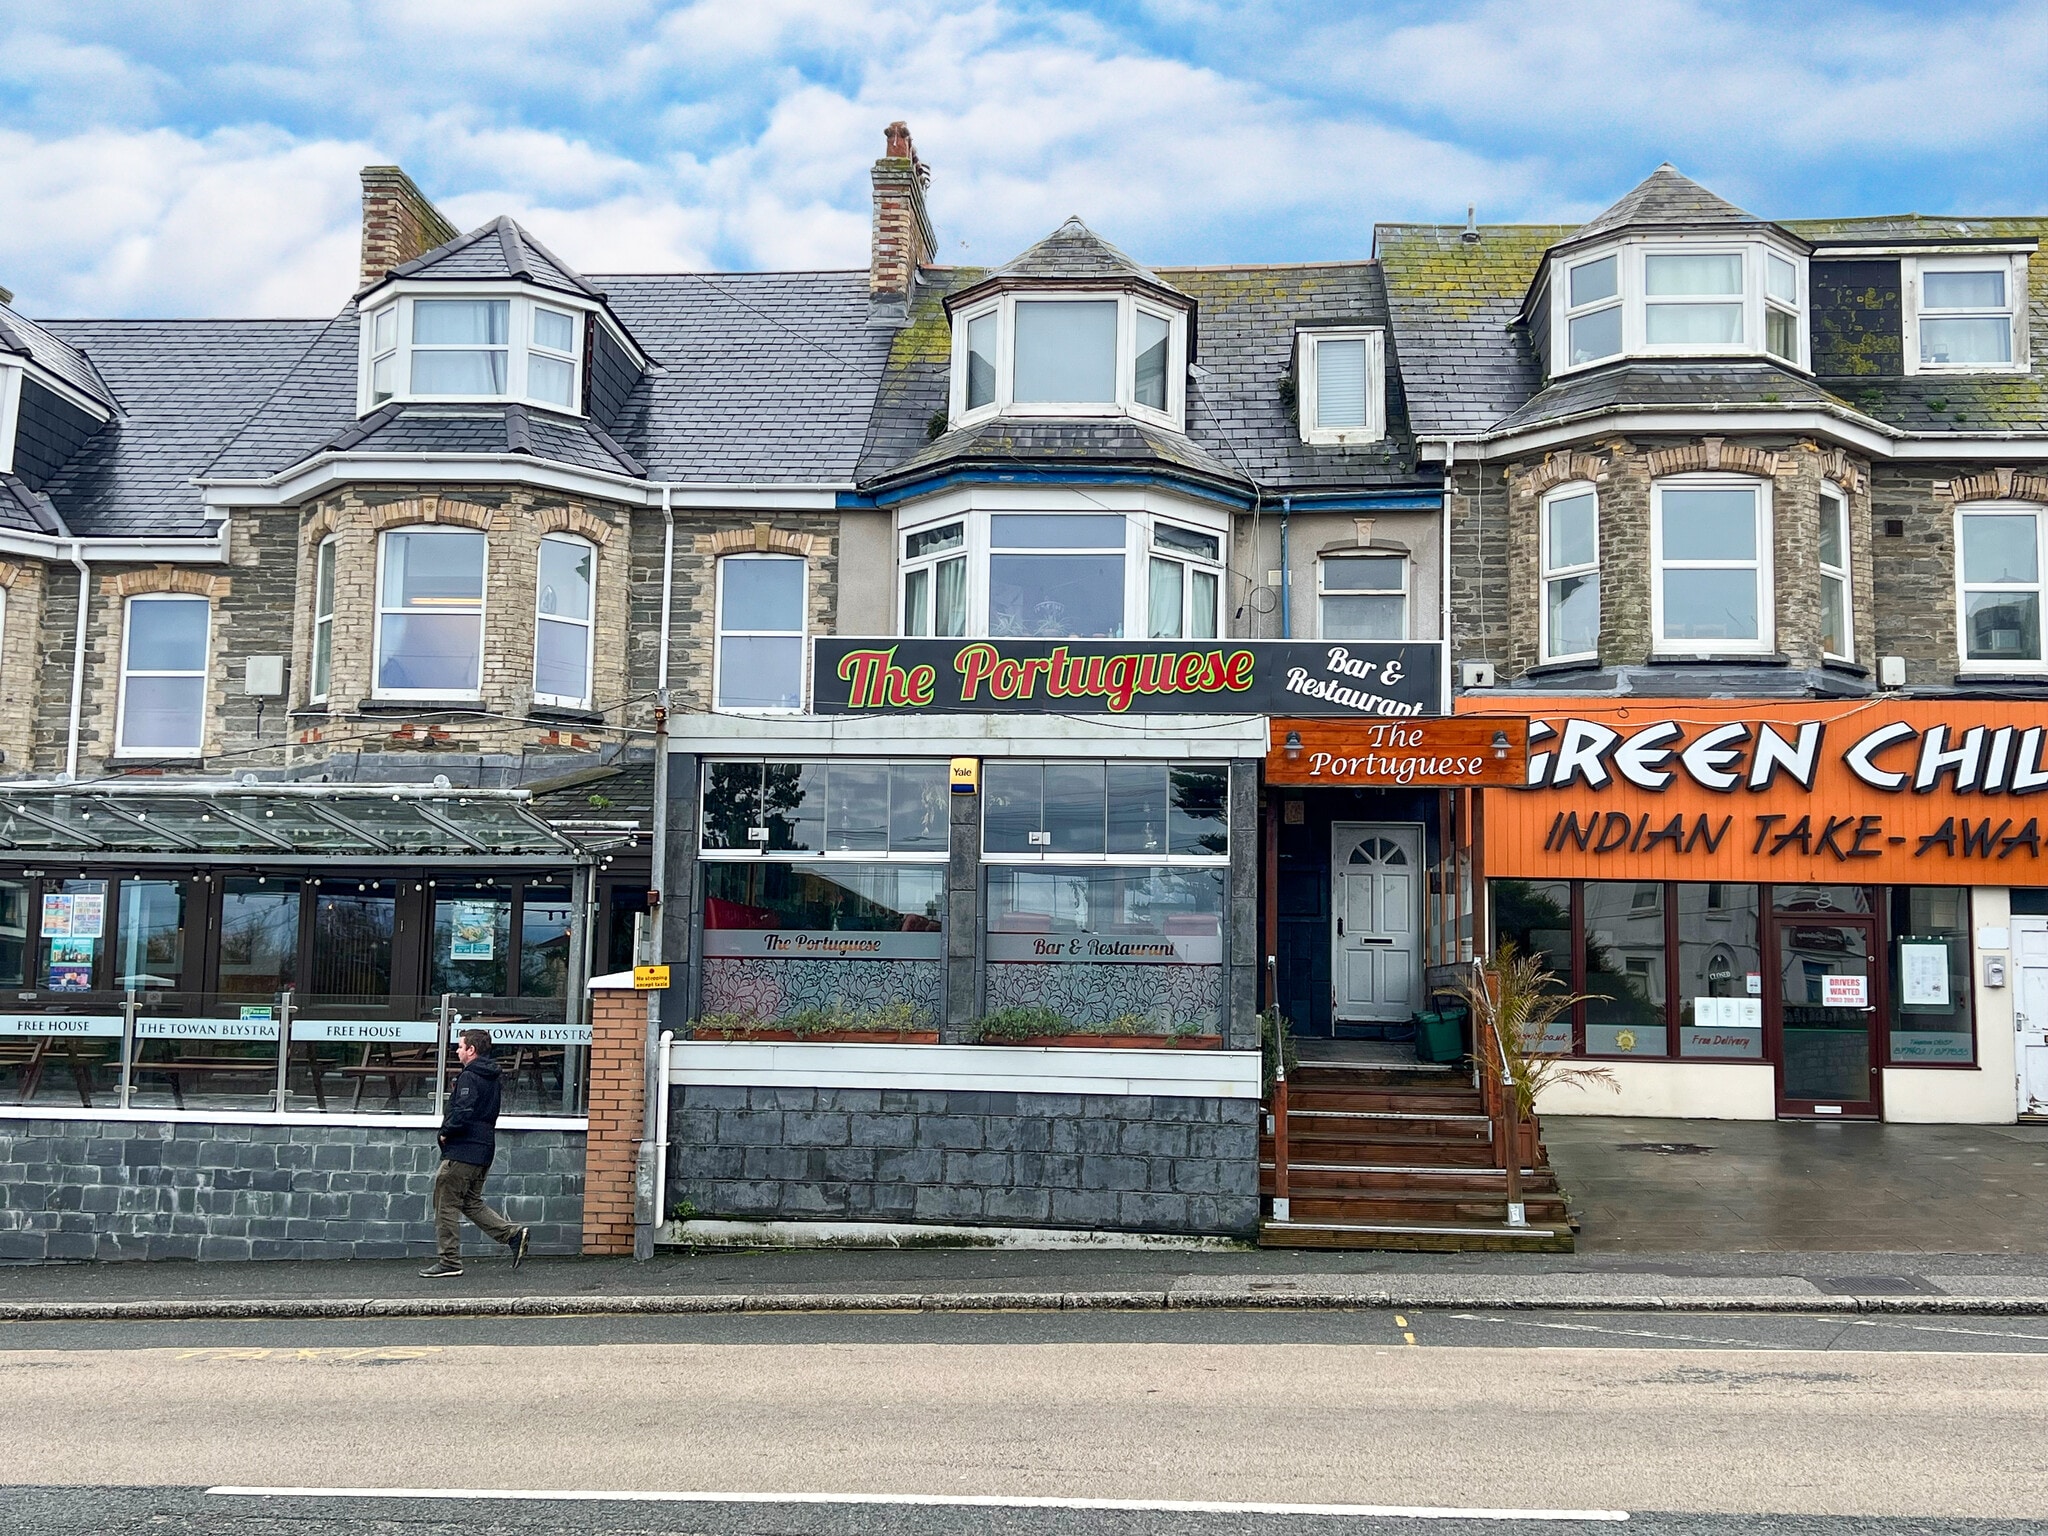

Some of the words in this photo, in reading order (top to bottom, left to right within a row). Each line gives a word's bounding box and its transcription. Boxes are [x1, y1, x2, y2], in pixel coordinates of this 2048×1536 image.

[1327, 647, 1377, 679] Bar
[1380, 660, 1405, 686] &
[838, 644, 936, 708] The
[953, 642, 1256, 713] Portuguese
[1286, 666, 1424, 716] Restaurant
[1367, 720, 1423, 748] The
[954, 768, 972, 776] Yale
[1308, 752, 1483, 785] Portuguese
[1545, 811, 1733, 855] INDIAN
[764, 934, 792, 951] The
[795, 934, 882, 956] Portuguese
[1033, 938, 1065, 955] Bar
[1069, 938, 1083, 955] &
[1087, 938, 1175, 956] Restaurant
[1829, 979, 1860, 987] DRIVERS
[1830, 988, 1860, 996] WANTED
[17, 1021, 45, 1031] FREE
[48, 1021, 90, 1032] HOUSE
[140, 1023, 166, 1034] THE
[169, 1023, 217, 1035] TOWAN
[222, 1025, 275, 1036] BLYSTRA
[326, 1025, 355, 1036] FREE
[358, 1026, 401, 1037] HOUSE
[1692, 1034, 1711, 1044] Free
[1713, 1035, 1750, 1049] Delivery
